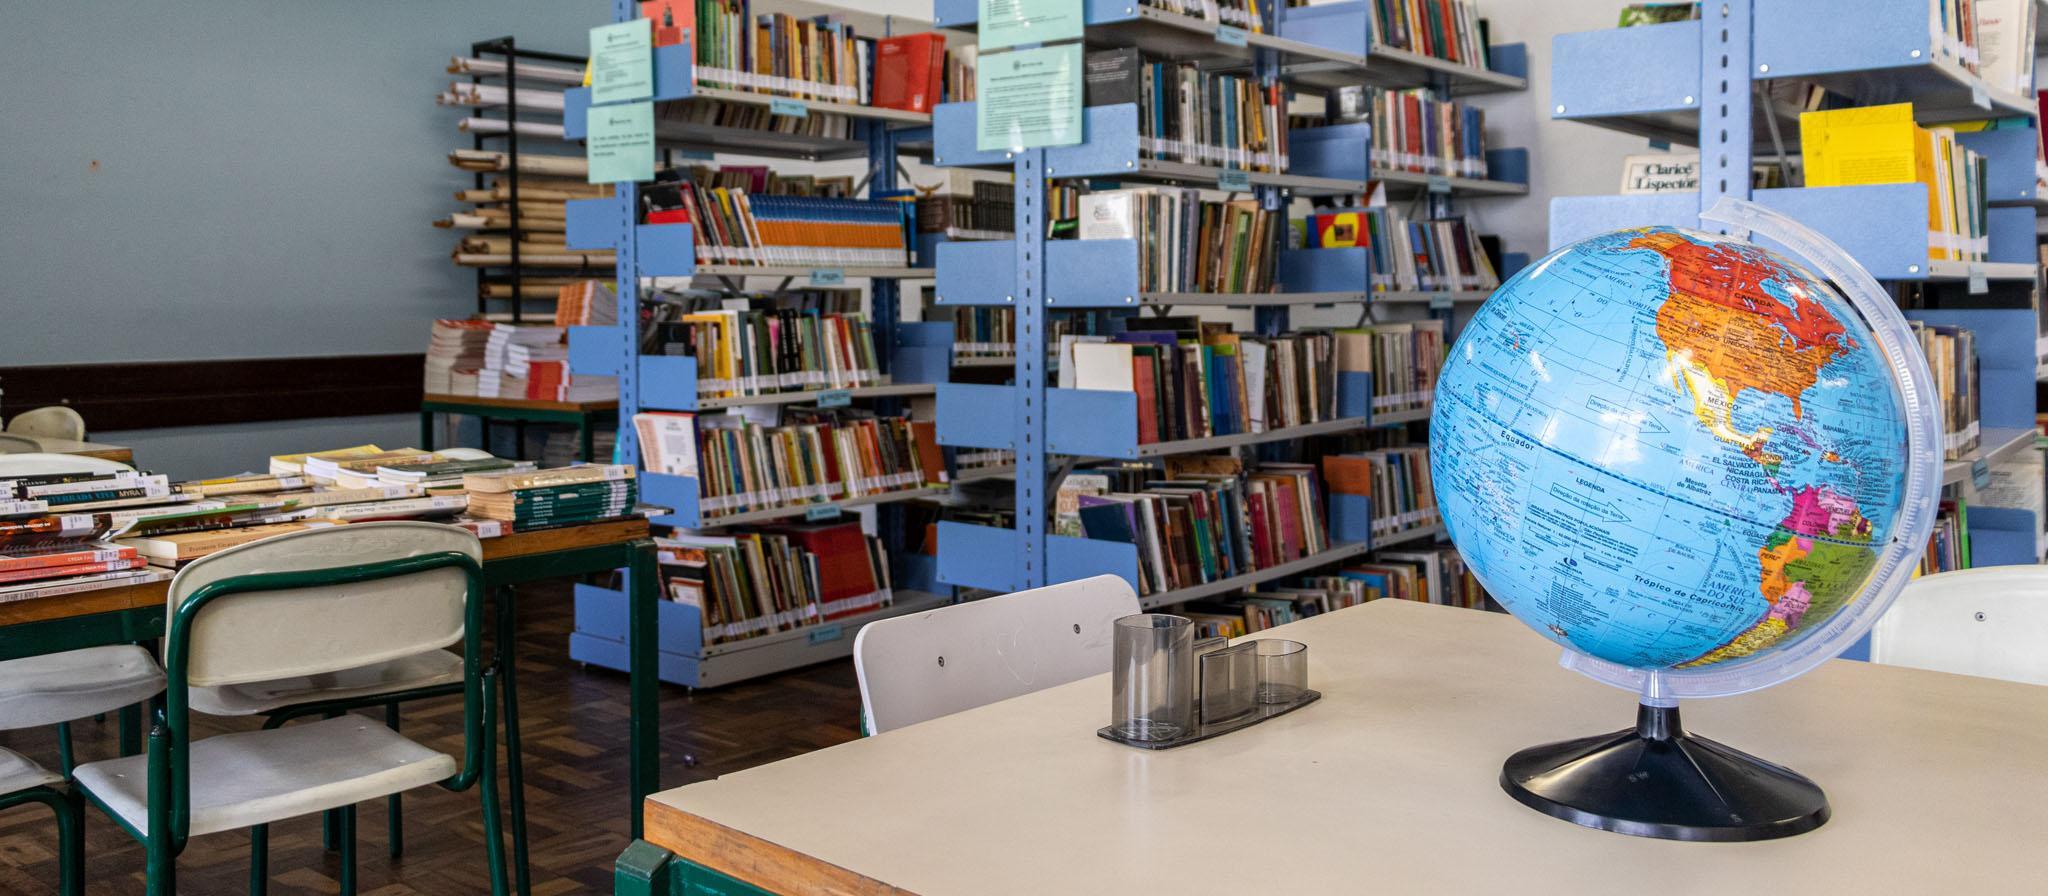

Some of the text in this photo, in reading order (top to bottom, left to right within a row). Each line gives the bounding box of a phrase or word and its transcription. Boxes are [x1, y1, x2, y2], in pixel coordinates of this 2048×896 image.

[1646, 163, 1692, 175] Clarice
[1635, 177, 1697, 191] Lispector
[1687, 325, 1750, 350] ESTADOS UNIDOS
[1500, 430, 1535, 452] Equador
[1712, 456, 1757, 469] EL SALVADOR
[1576, 477, 1605, 493] LEGENDA
[1685, 477, 1707, 488] Meseta
[1725, 474, 1768, 486] COSTA RICA
[1552, 486, 1573, 501] Direção
[1676, 481, 1712, 496] de Albatroz
[1634, 574, 1744, 613] Trópico de Capricórnio
[1706, 590, 1746, 606] DO SUL
